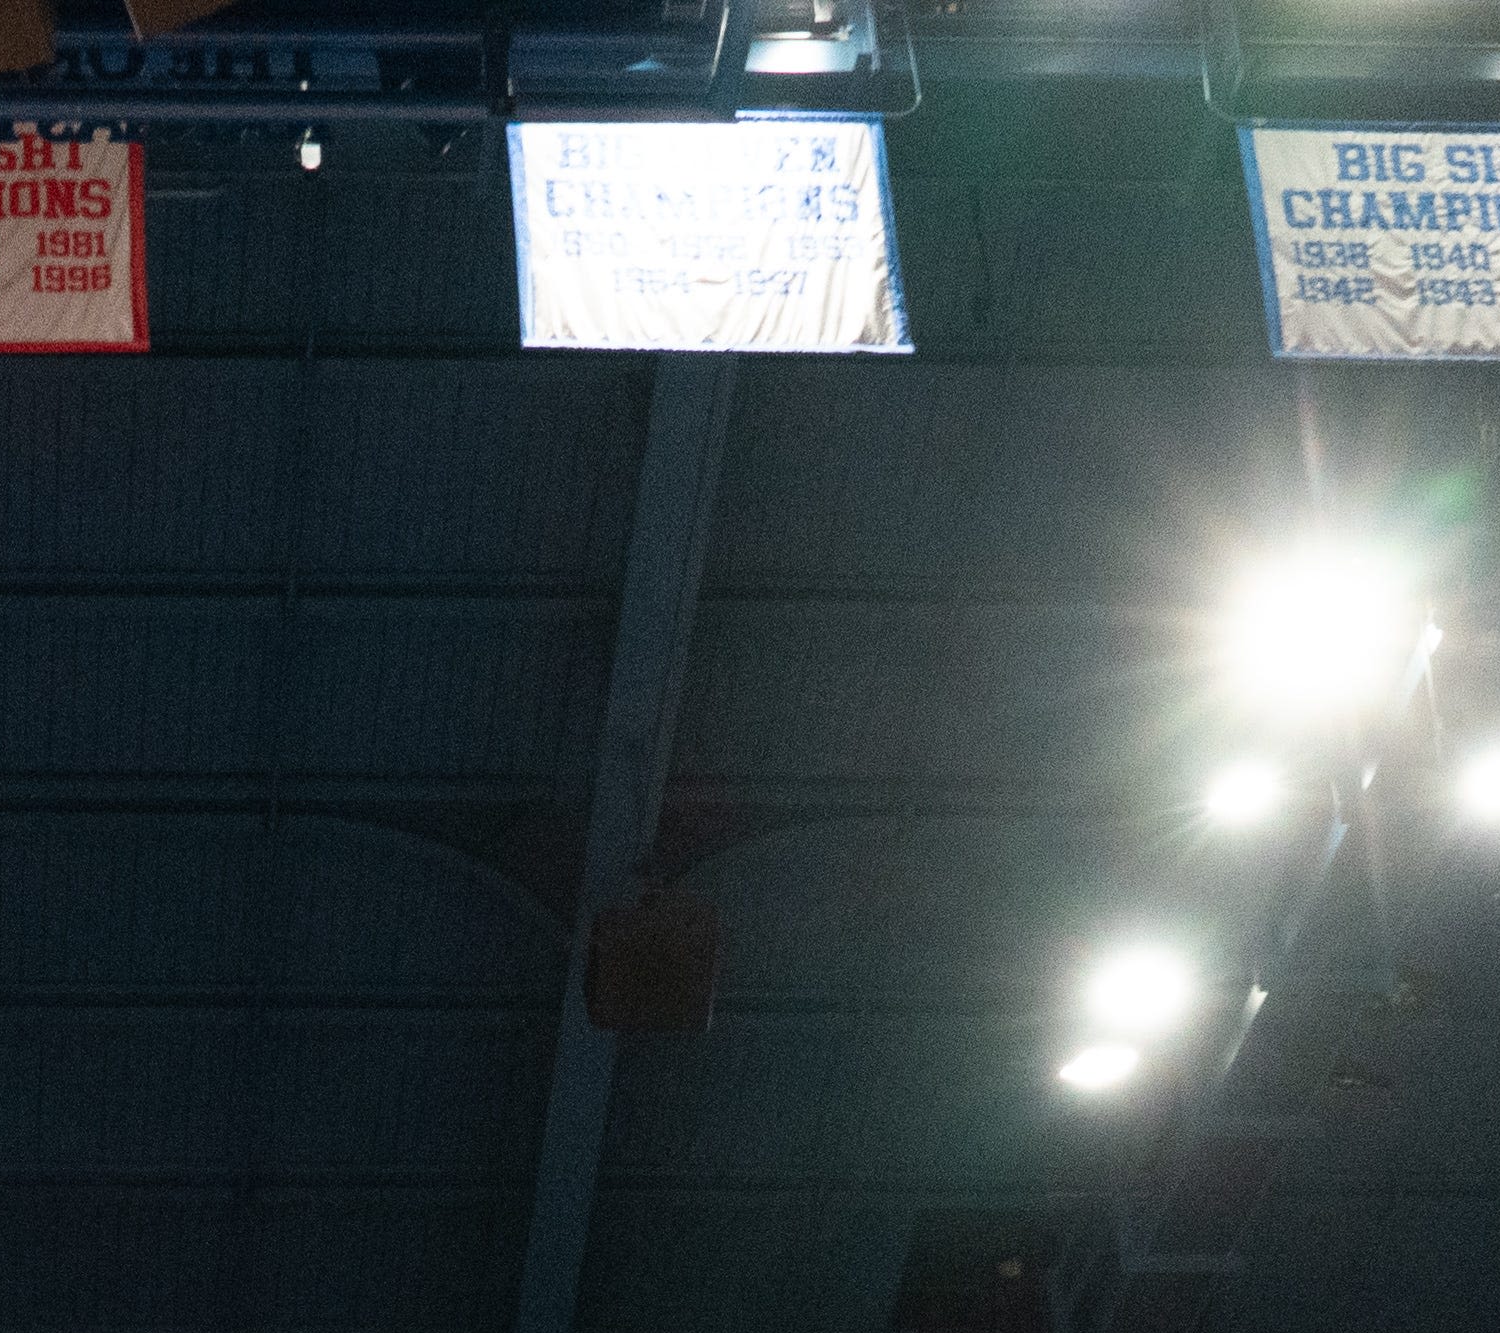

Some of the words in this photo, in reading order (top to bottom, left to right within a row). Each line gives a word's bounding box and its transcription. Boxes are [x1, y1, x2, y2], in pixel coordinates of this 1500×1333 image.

[1331, 142, 1427, 183] BIG
[35, 230, 108, 259] 1981
[1410, 241, 1492, 272] 1940
[31, 262, 112, 294] 1996
